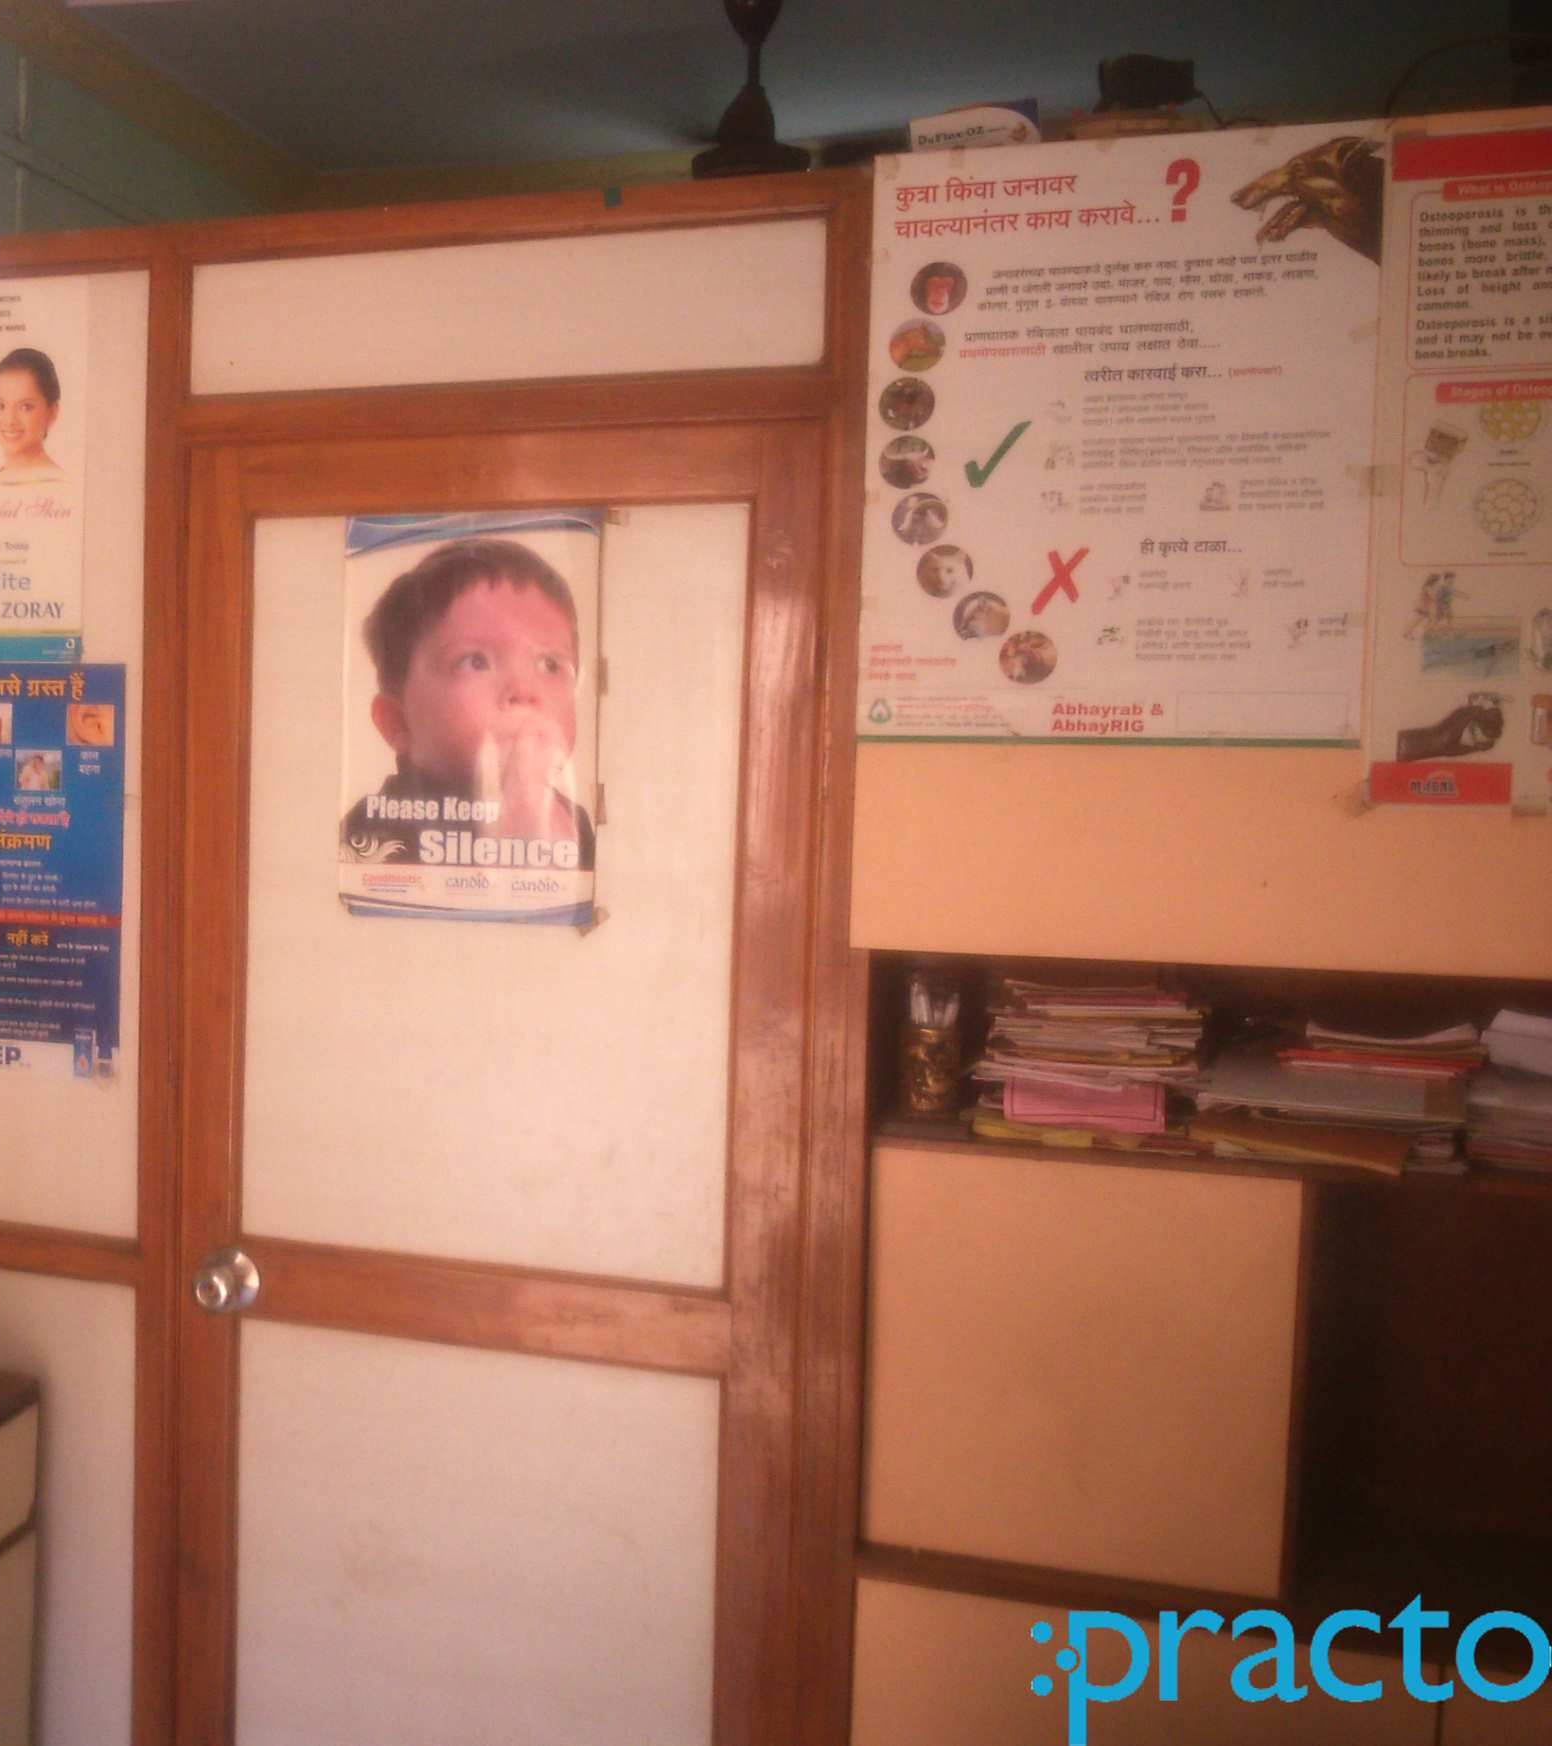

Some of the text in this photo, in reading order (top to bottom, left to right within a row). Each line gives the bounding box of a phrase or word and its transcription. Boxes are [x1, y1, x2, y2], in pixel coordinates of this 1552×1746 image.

[896, 175, 1078, 211] कुत्रा किंवा जनावर
[1419, 209, 1504, 223] Osteoporosis
[1516, 204, 1527, 217] is
[895, 208, 1019, 239] चावल्यानंतर
[1025, 210, 1072, 230] काय
[1419, 221, 1538, 238] thinning and loss
[1418, 241, 1456, 252] bones
[1418, 256, 1455, 267] bones
[1464, 255, 1497, 265] more
[1417, 265, 1540, 282] likely to break after
[1417, 286, 1445, 297] Loss
[1457, 283, 1470, 294] of
[1481, 280, 1521, 295] height
[1416, 316, 1531, 330] Osteoporosis is a
[1416, 330, 1533, 345] and it may not be
[1415, 349, 1444, 360] bone
[1127, 362, 1177, 381] कारवाई
[0, 601, 65, 619] ZORAY
[27, 678, 66, 697] ग्रस्त
[1052, 703, 1164, 718] Abhayrab &
[1052, 719, 1145, 734] AbhayRIG
[366, 796, 499, 824] Please Keep
[418, 830, 580, 869] Silence
[445, 873, 490, 890] candid
[512, 876, 560, 893] candid
